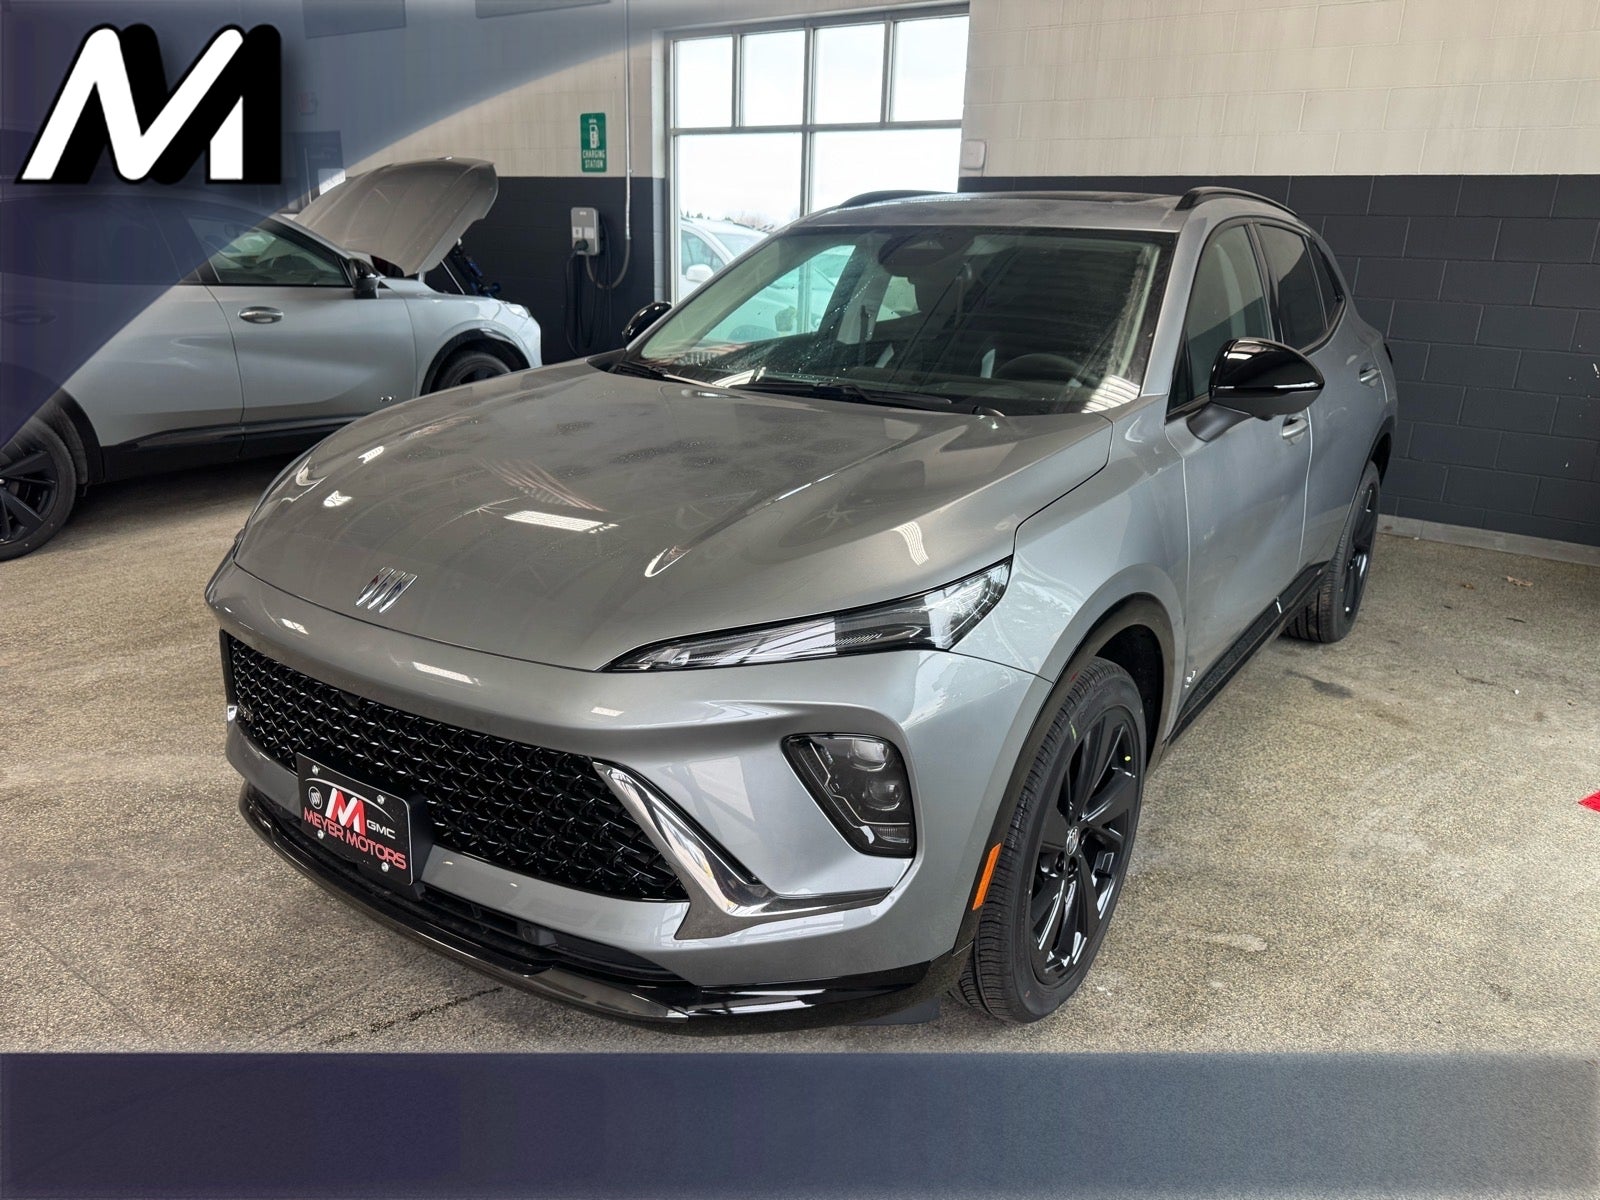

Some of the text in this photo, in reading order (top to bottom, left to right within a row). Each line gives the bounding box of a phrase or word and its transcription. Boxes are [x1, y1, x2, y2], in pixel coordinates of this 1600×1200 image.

[303, 806, 407, 870] MEYER MOTORS
[366, 819, 396, 840] GMC
